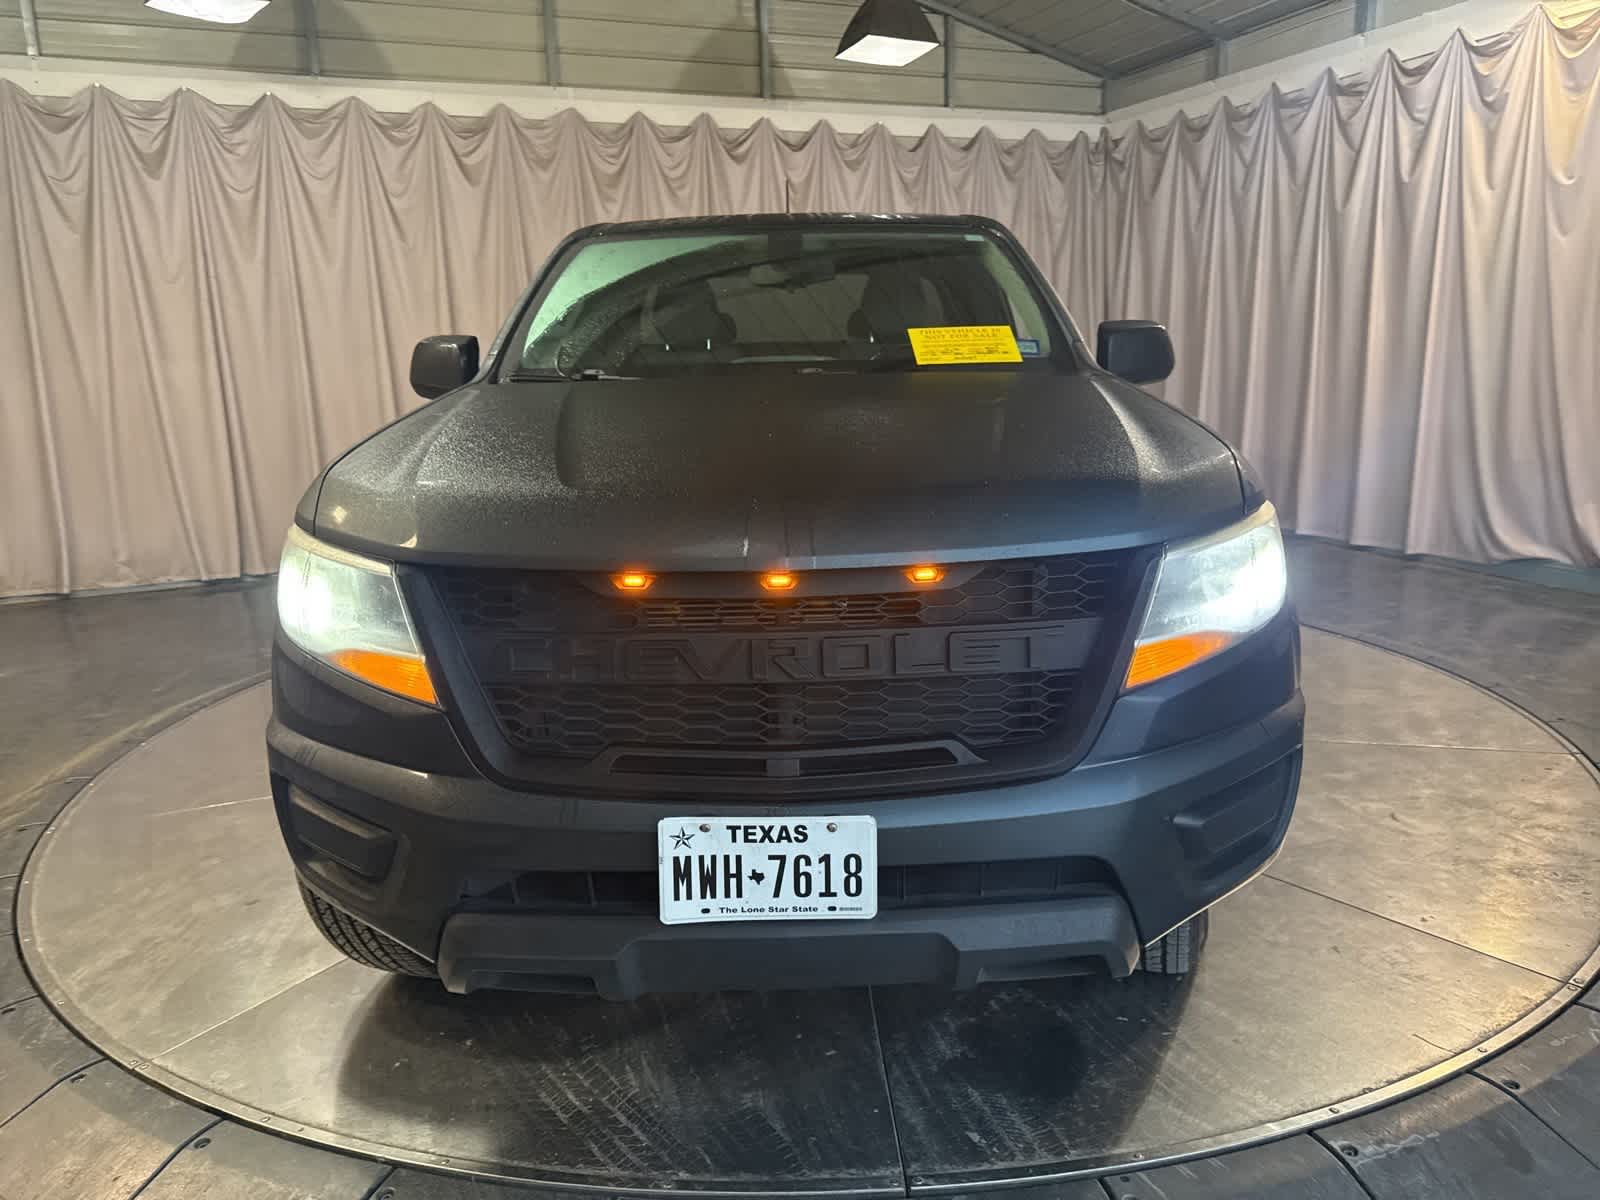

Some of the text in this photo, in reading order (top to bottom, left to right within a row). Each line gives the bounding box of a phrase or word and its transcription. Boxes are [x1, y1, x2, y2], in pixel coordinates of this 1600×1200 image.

[497, 626, 1065, 682] CHEVROLET
[726, 824, 809, 844] TEXAS
[672, 853, 863, 901] MWH 7618
[719, 905, 819, 914] The Lone Star State
